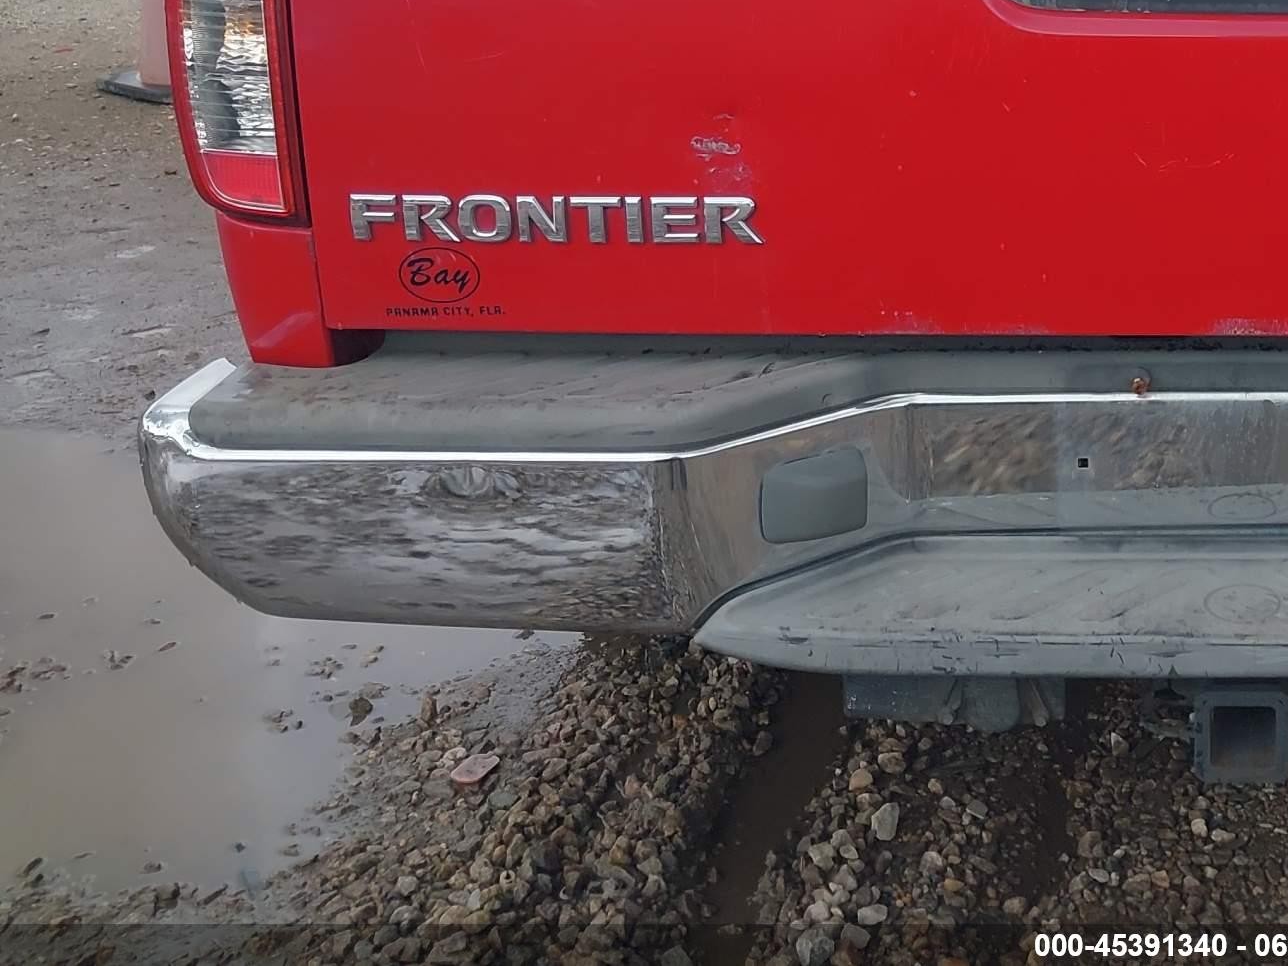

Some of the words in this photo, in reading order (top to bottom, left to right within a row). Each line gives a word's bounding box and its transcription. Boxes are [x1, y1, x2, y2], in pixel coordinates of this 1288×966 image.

[349, 193, 764, 244] FRONTIER
[407, 257, 470, 294] Bay
[386, 307, 438, 317] PANAMA
[443, 306, 474, 317] CITY,
[480, 306, 506, 315] FLA.
